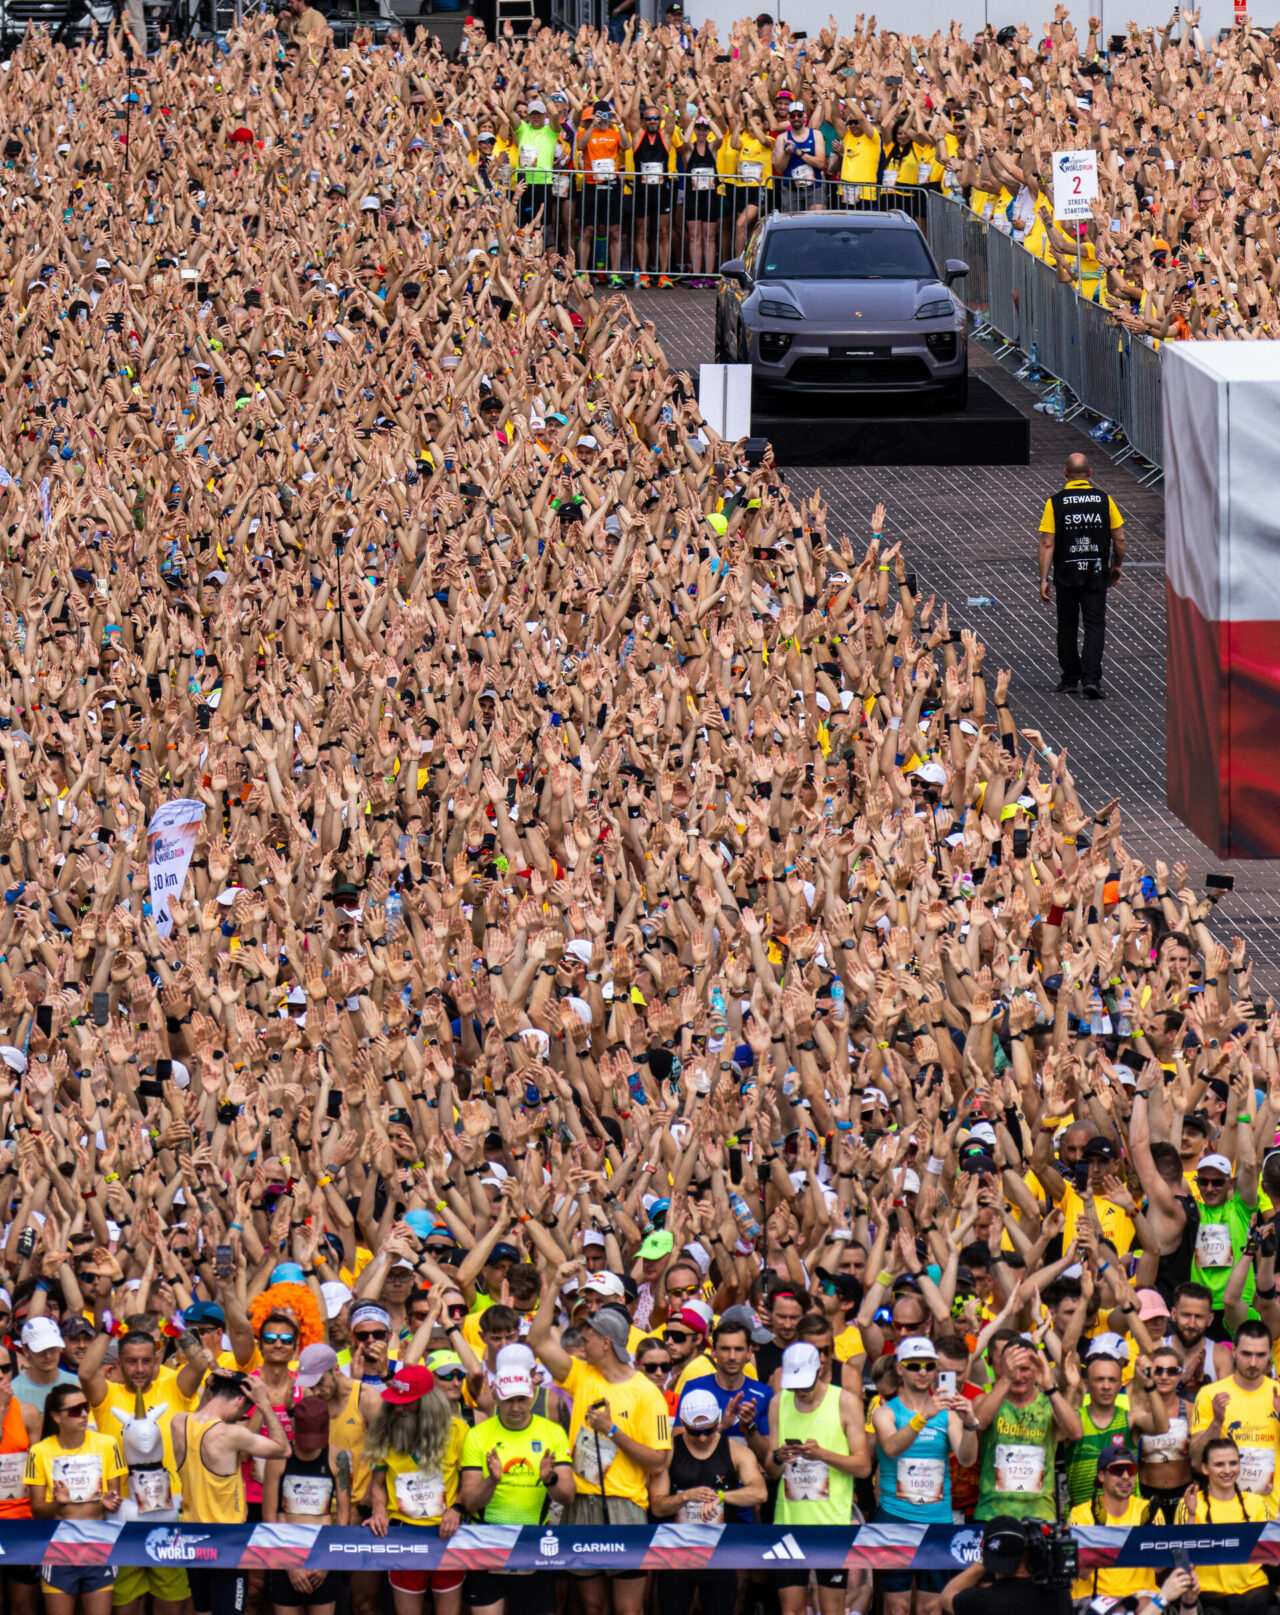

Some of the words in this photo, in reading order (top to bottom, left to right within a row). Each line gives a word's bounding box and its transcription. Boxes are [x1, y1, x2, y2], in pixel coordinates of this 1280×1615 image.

[1072, 176, 1082, 194] 2
[1067, 198, 1089, 206] STREFA
[1063, 495, 1101, 504] STEWARD
[1064, 512, 1102, 524] SOWA
[158, 853, 174, 863] WORLD
[165, 872, 178, 887] km
[1235, 1434, 1261, 1442] WORLD
[329, 1544, 429, 1553] PORSCHE
[572, 1543, 625, 1552] GARMIN
[1140, 1538, 1240, 1550] PORSCHE
[157, 1547, 196, 1560] WORLD
[195, 1547, 217, 1560] RUN
